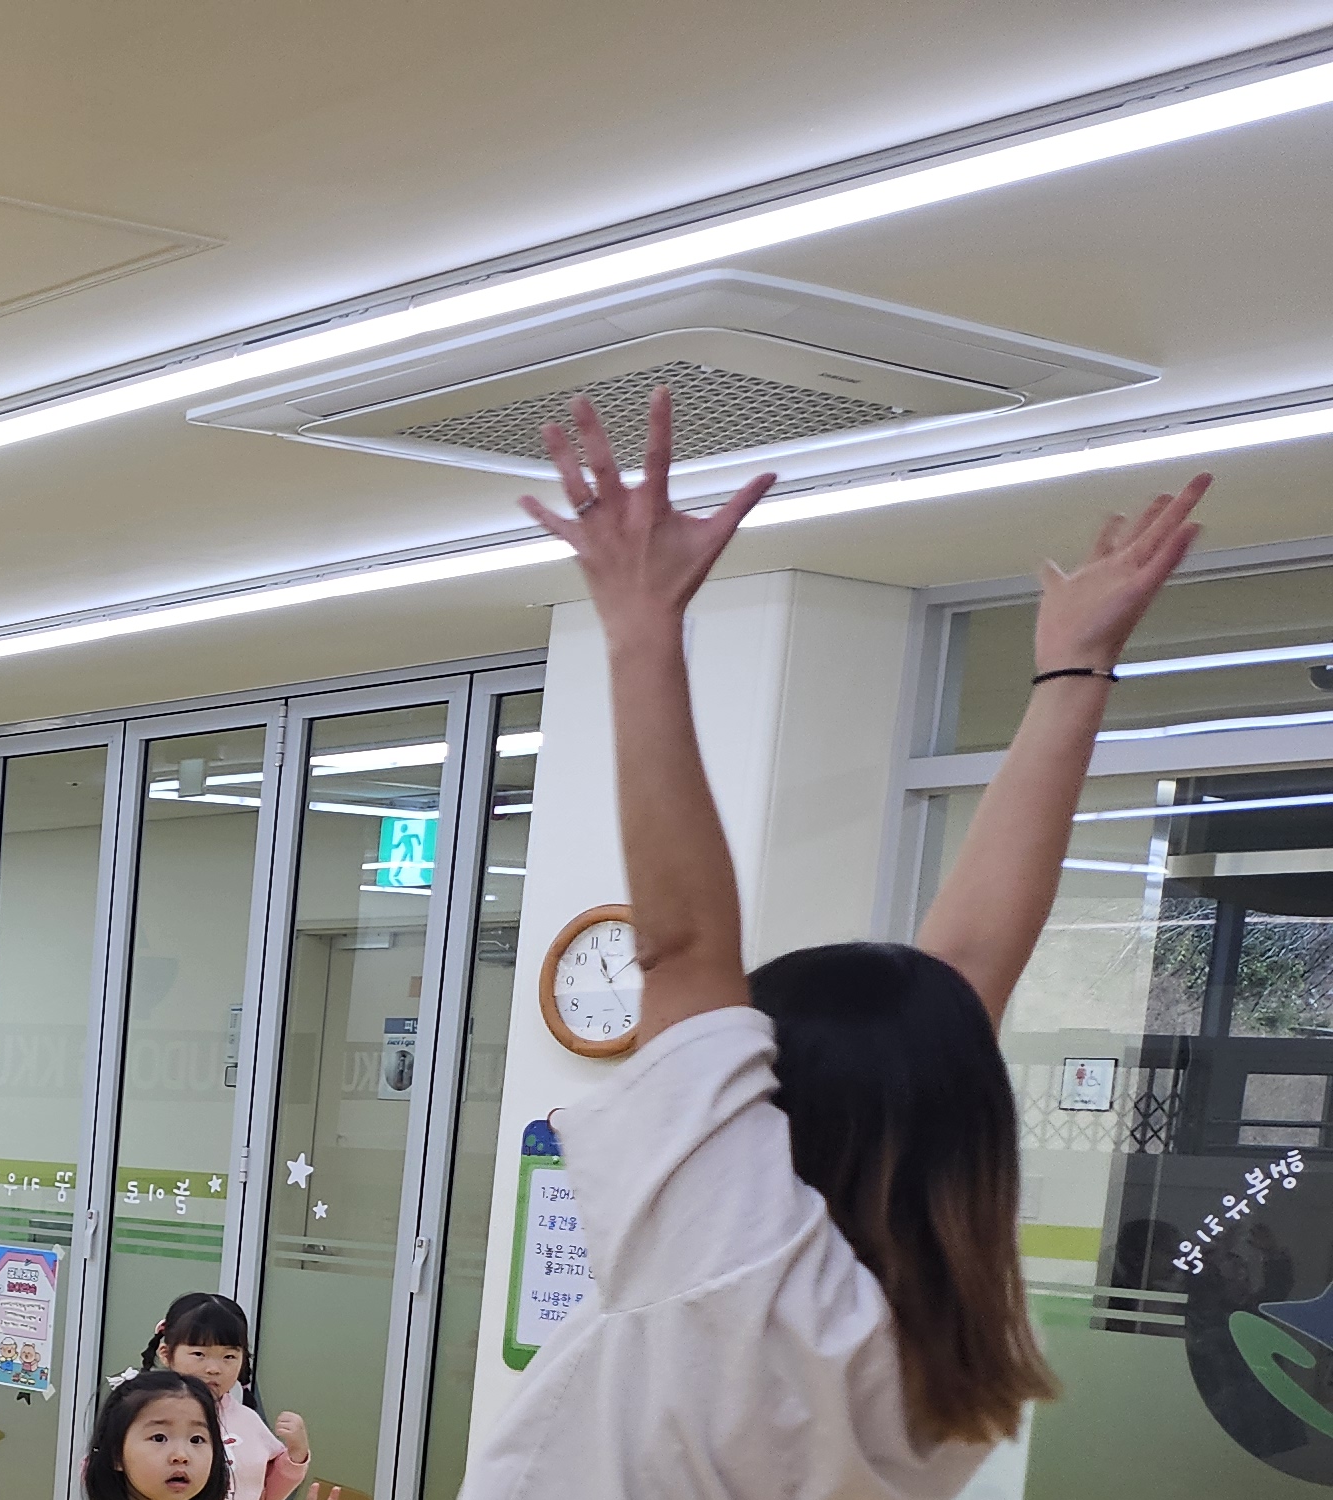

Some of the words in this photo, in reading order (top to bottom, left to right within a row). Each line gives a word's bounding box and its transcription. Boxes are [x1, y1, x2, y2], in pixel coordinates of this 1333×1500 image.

[609, 928, 621, 942] 12
[590, 937, 599, 950] 11
[575, 953, 587, 965] 10
[566, 976, 574, 986] 9
[570, 998, 579, 1011] 8
[585, 1016, 593, 1028] 7
[603, 1021, 611, 1034] 6
[622, 1014, 632, 1028] 5
